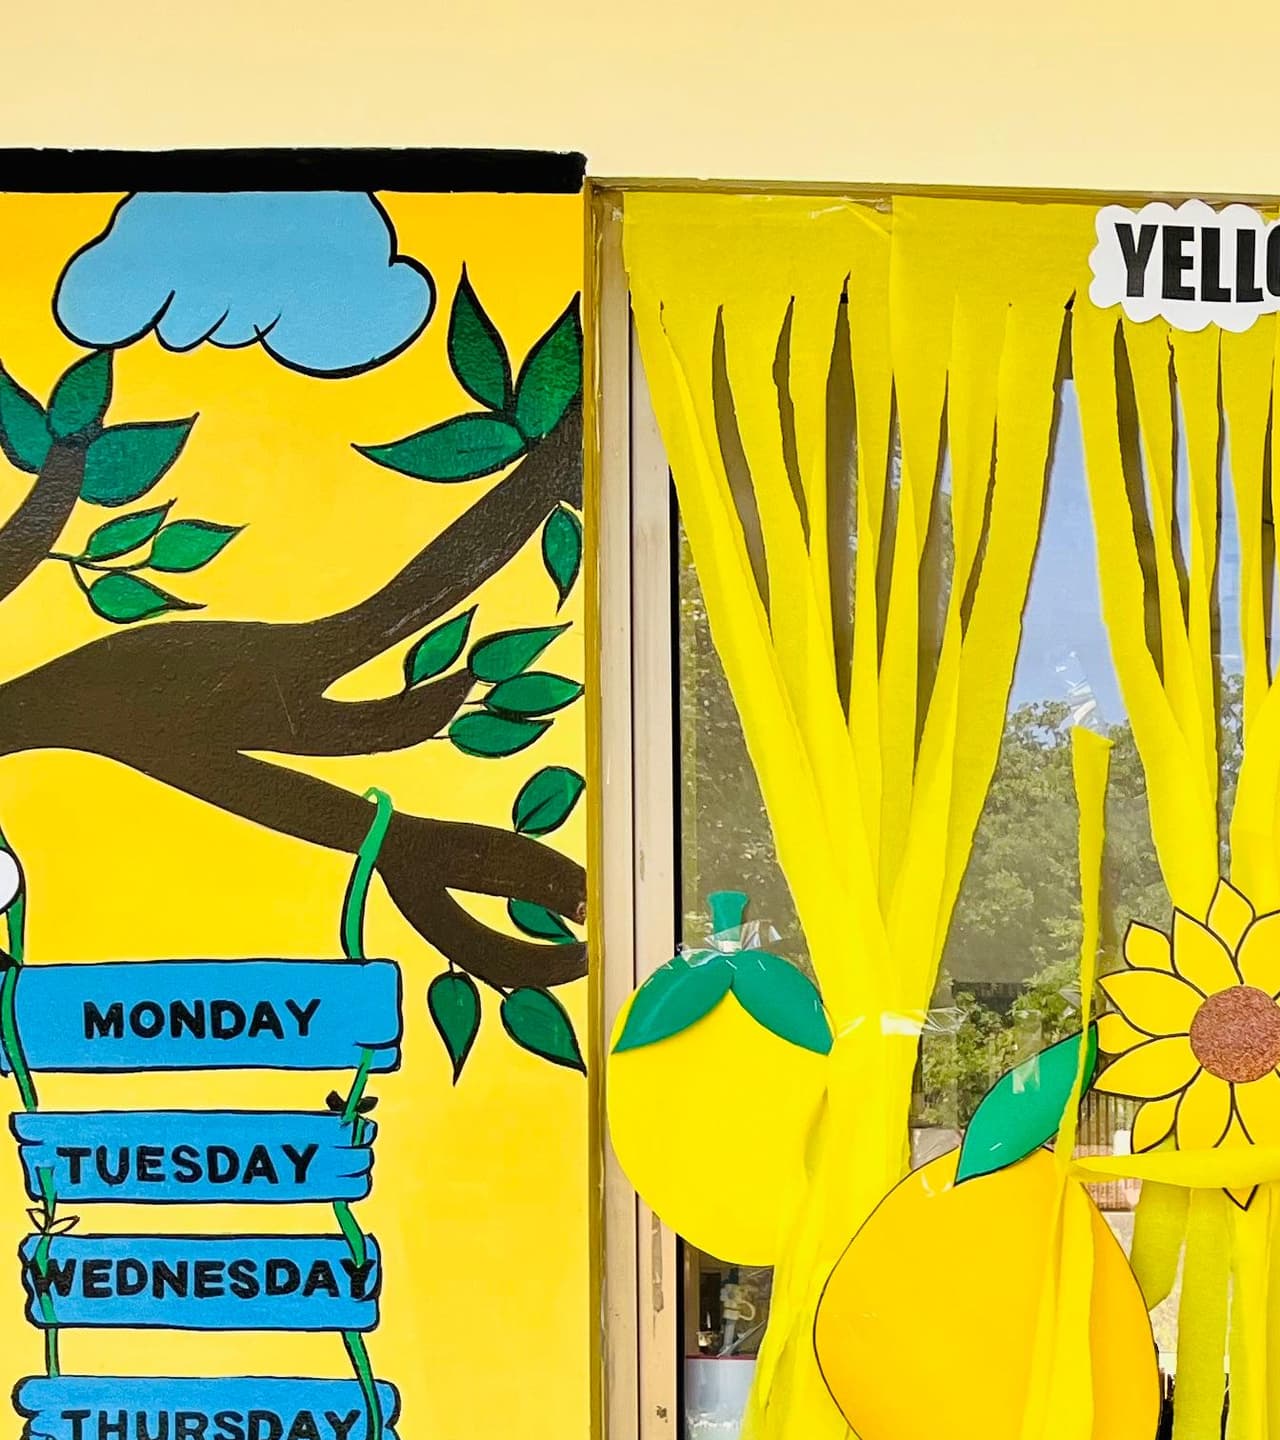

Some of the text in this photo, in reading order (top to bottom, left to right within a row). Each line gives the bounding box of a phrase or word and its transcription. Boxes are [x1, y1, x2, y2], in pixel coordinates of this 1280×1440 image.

[85, 998, 321, 1040] MONDAY
[57, 1143, 318, 1186] TUESDAY
[29, 1258, 375, 1299] WEDNESDAY
